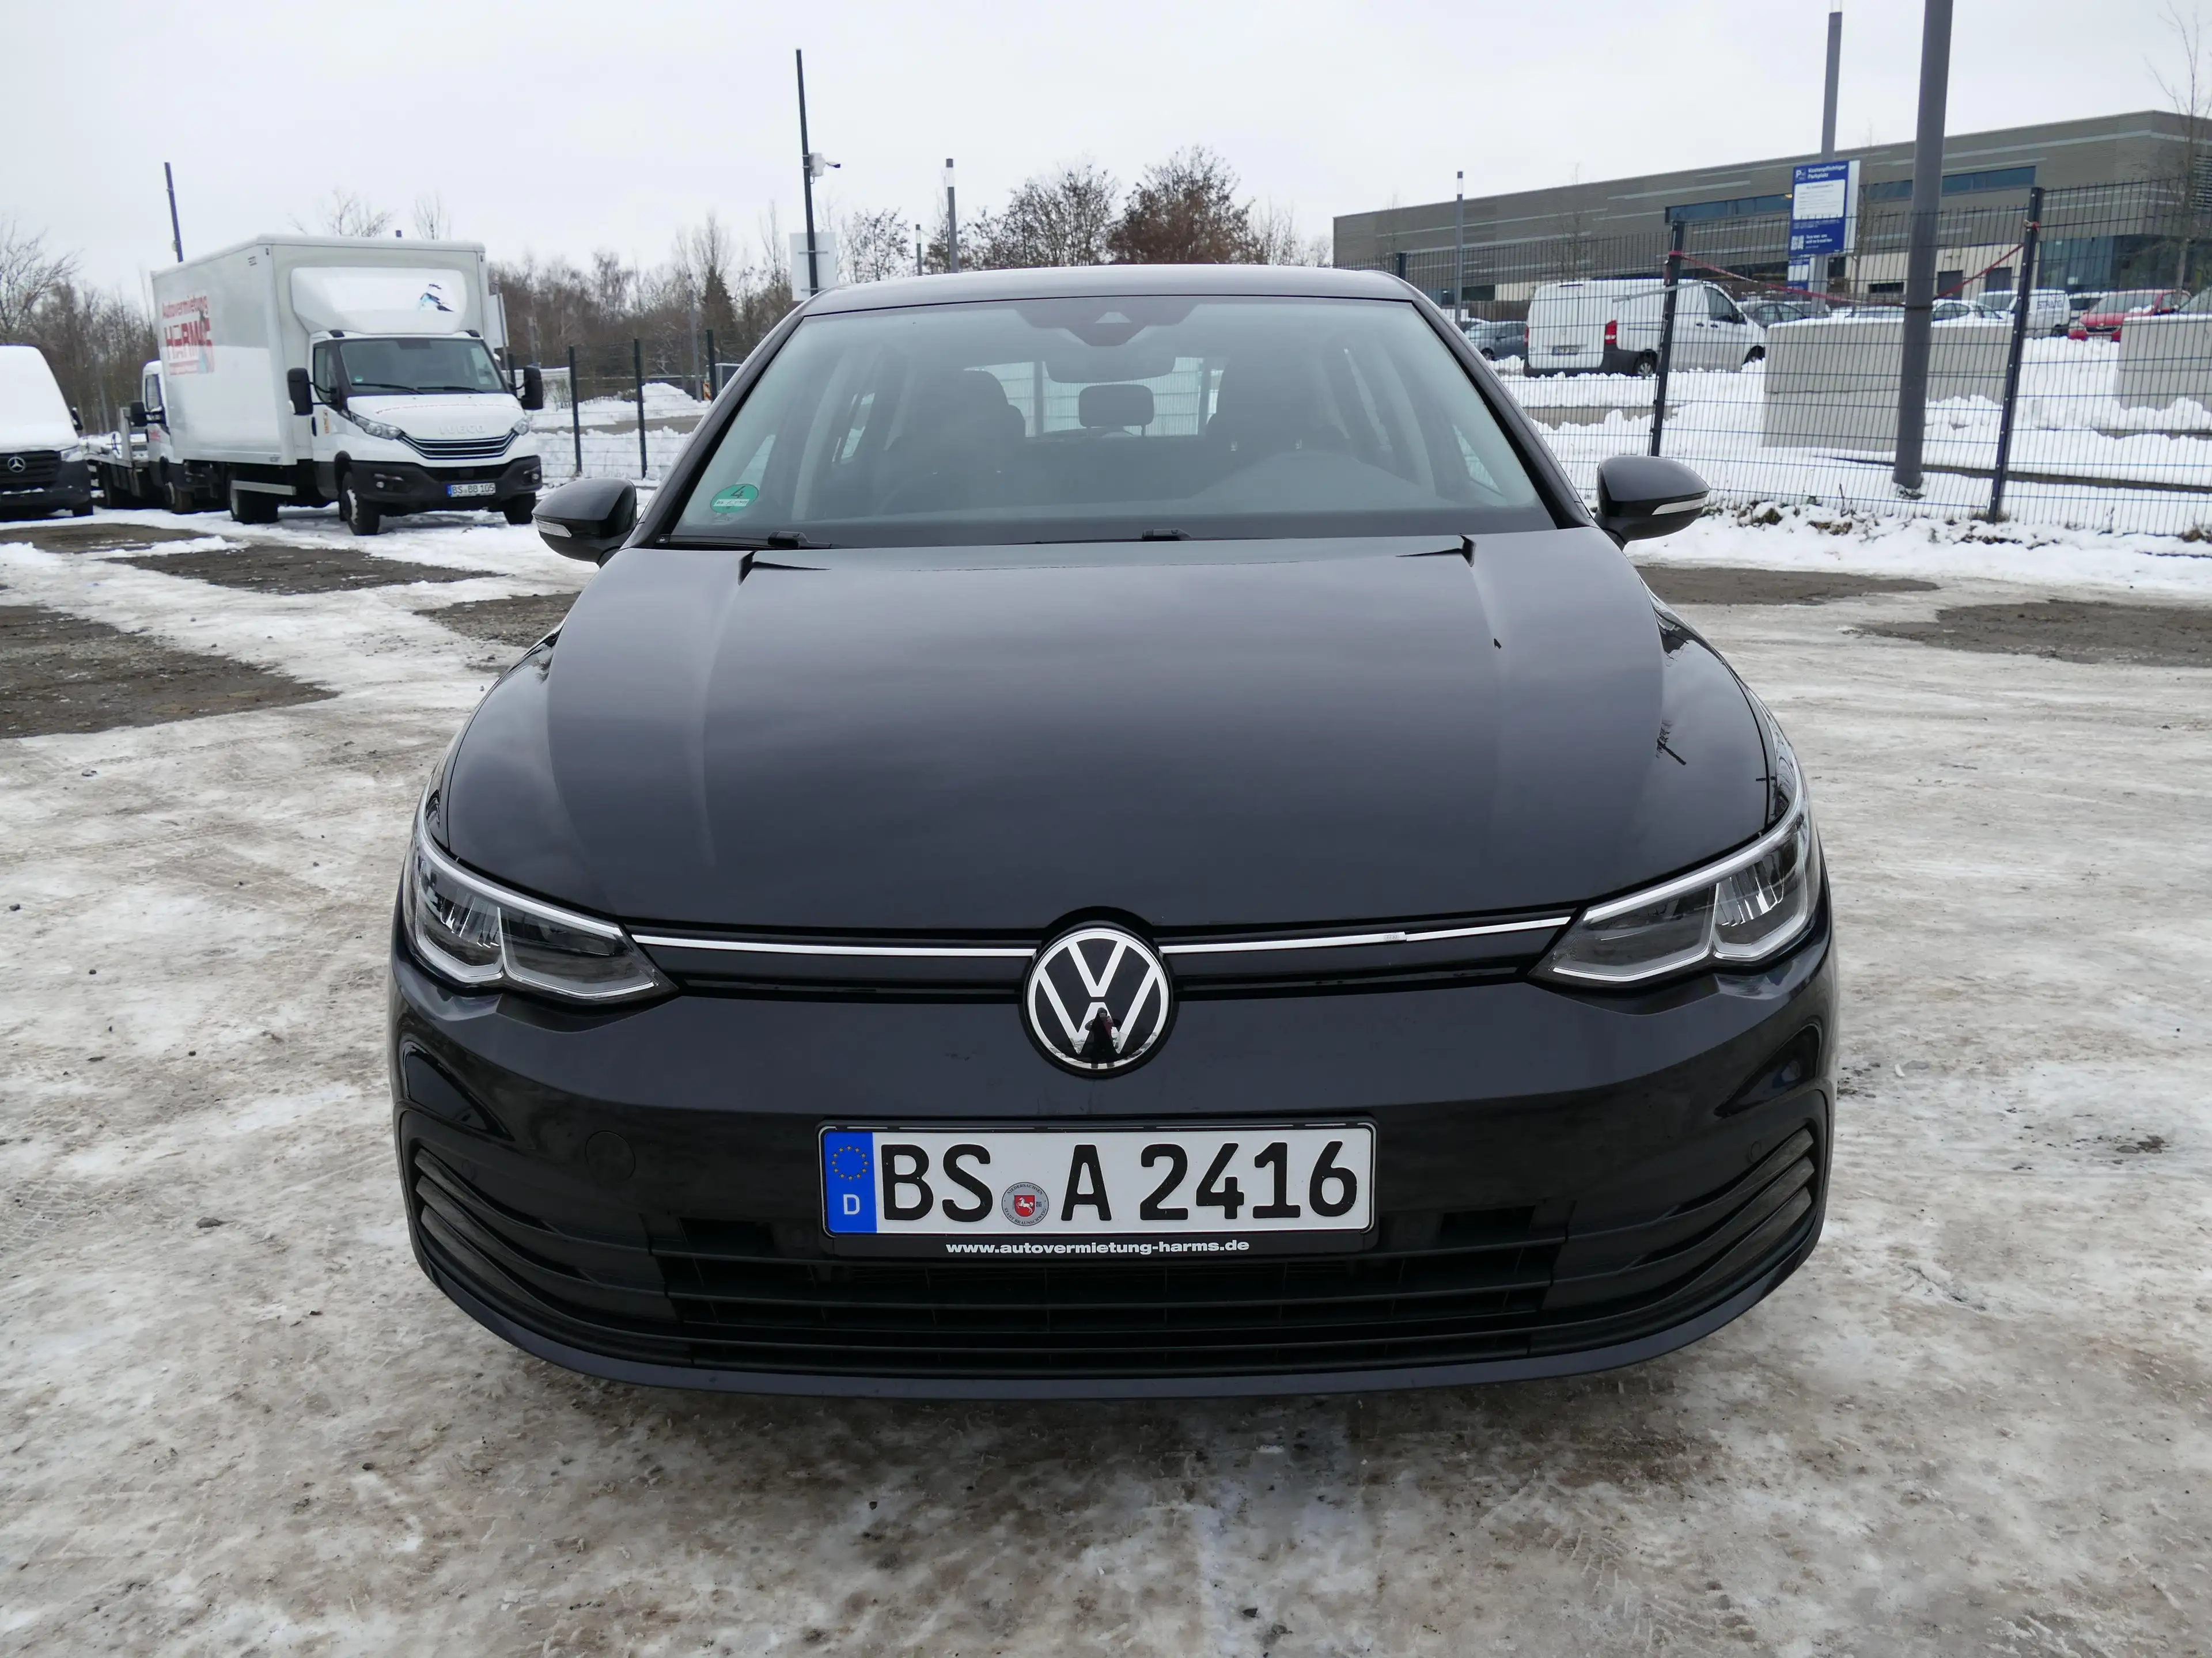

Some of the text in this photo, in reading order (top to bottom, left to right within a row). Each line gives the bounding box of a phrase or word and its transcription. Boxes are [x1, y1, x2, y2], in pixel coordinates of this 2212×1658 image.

[452, 485, 463, 494] BS
[730, 485, 745, 499] 4
[881, 1141, 1358, 1221] BS A 2416
[1007, 1184, 1043, 1195] NIEDERSACHSEN
[843, 1194, 860, 1215] D
[1004, 1208, 1047, 1225] STADT BRAUNSCHWEIG
[946, 1240, 1249, 1254] www.autovermietung-harms.de
